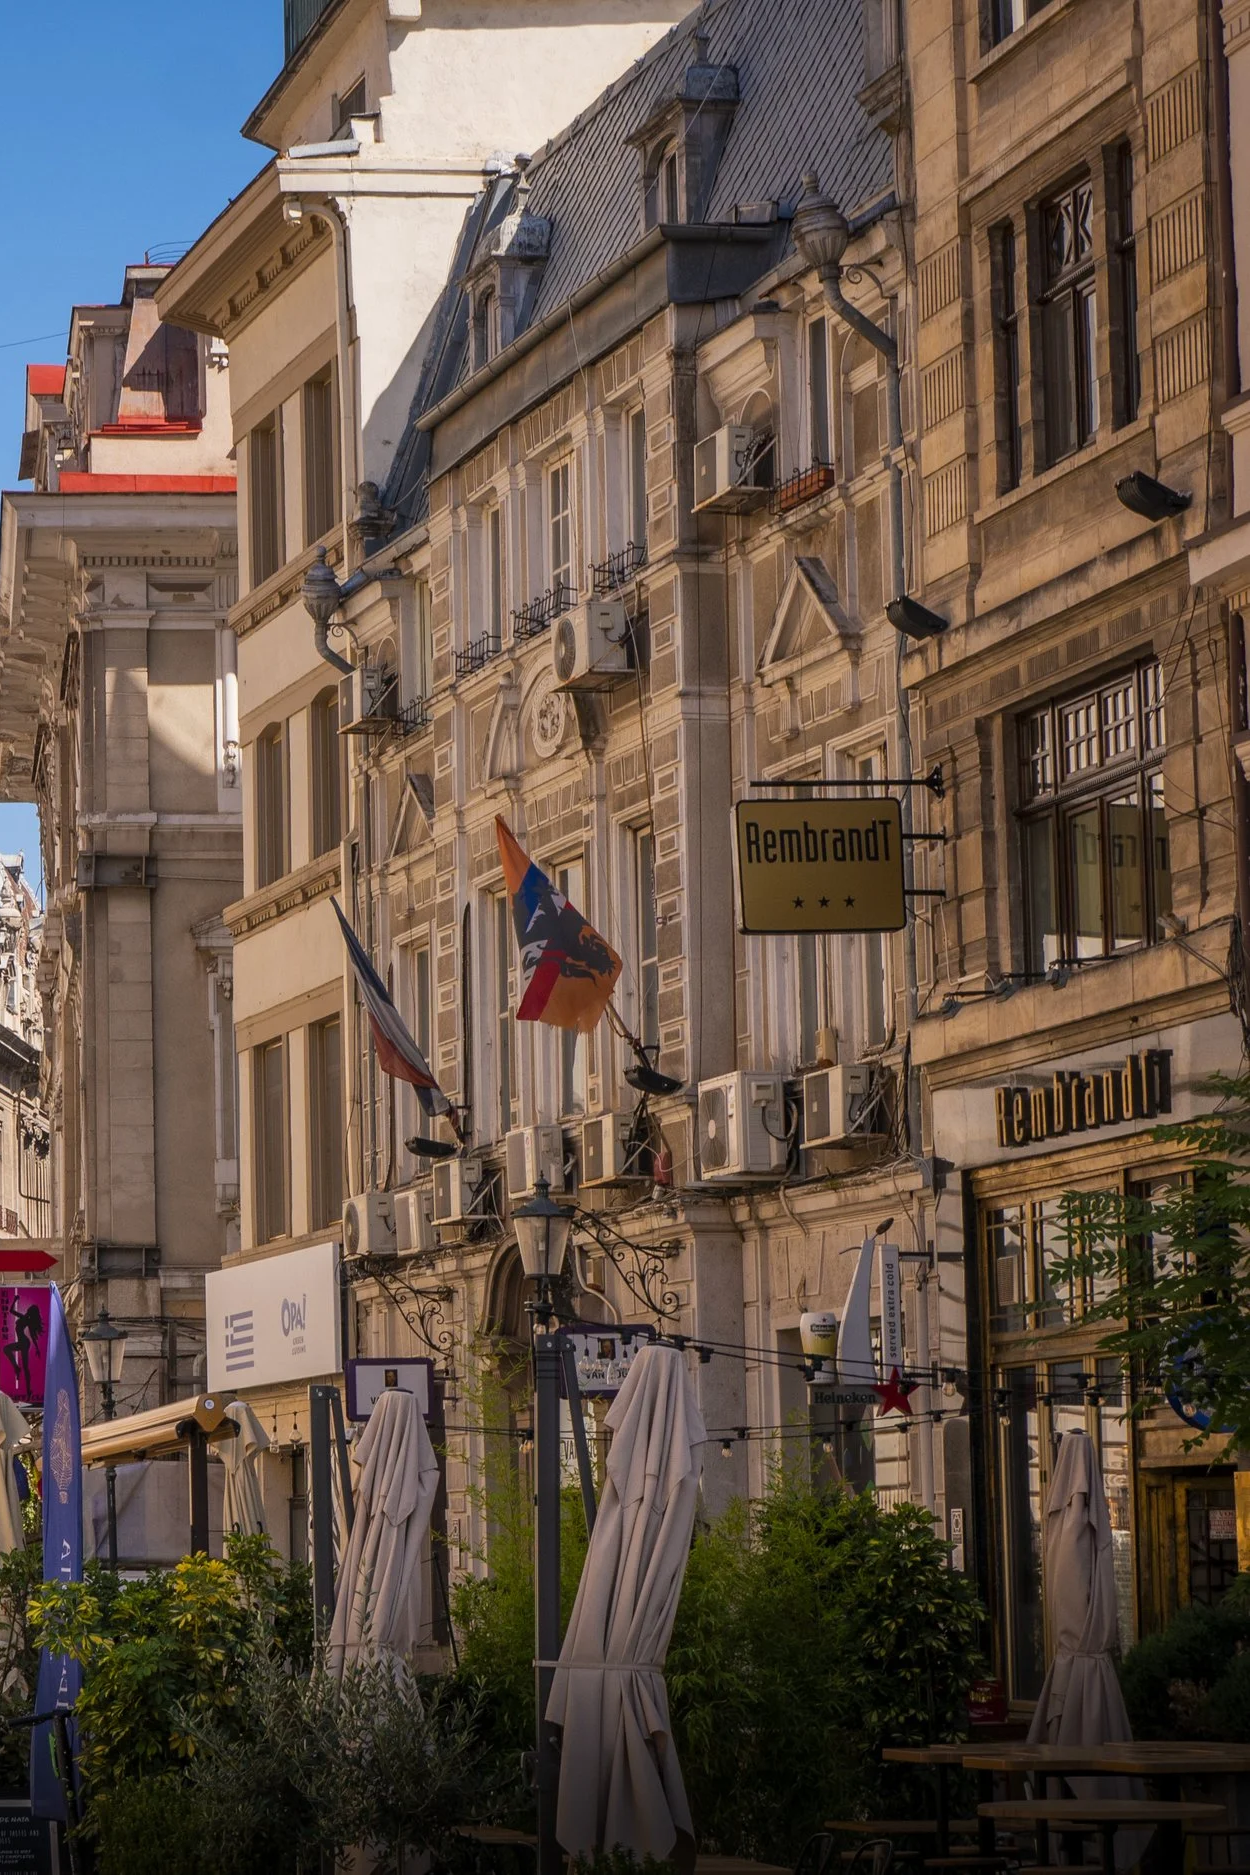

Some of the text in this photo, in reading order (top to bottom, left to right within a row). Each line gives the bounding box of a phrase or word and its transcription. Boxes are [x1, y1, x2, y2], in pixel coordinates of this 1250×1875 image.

[281, 1294, 306, 1337] OPA!
[885, 1263, 897, 1358] served extra cold
[814, 1390, 877, 1404] Heineken
